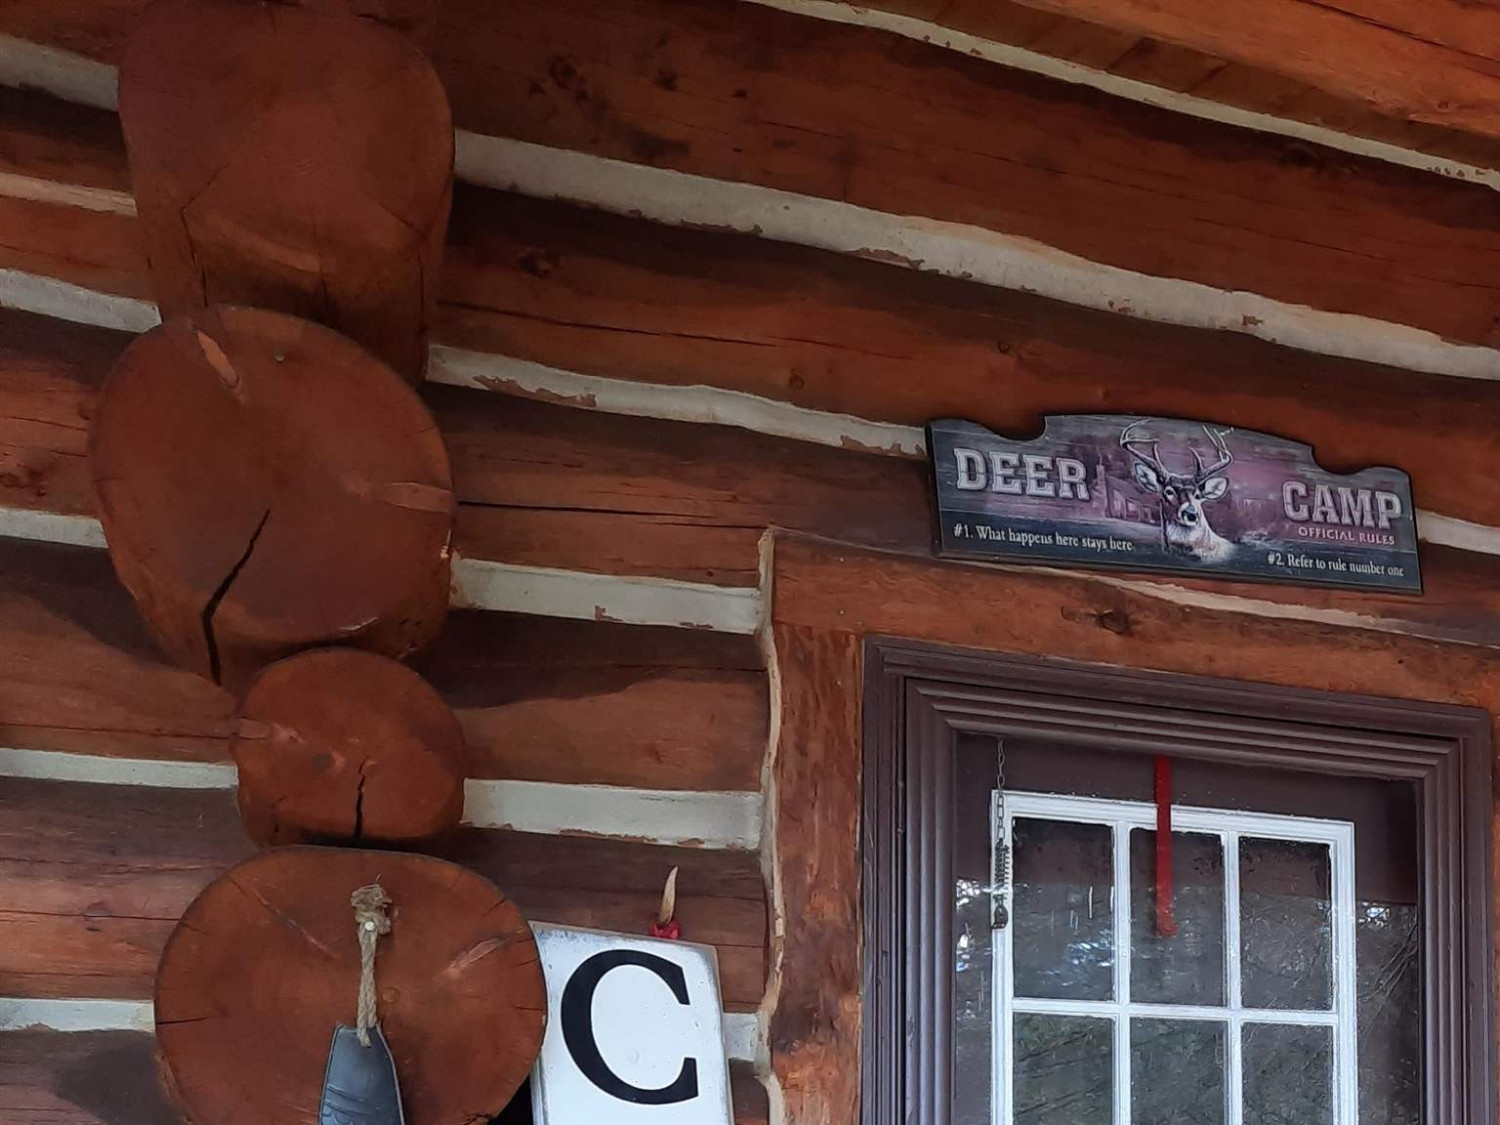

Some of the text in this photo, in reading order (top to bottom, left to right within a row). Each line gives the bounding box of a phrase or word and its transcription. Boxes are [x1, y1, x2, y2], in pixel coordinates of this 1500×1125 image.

[954, 448, 1402, 529] DEER CAMP
[953, 523, 974, 539] #1.
[976, 526, 1006, 541] What
[1008, 528, 1053, 547] happens
[1055, 532, 1079, 547] here
[1081, 537, 1107, 553] stays
[1298, 527, 1395, 546] OFFICIAL RULES
[1268, 552, 1405, 577] #2. Refer to rule number one
